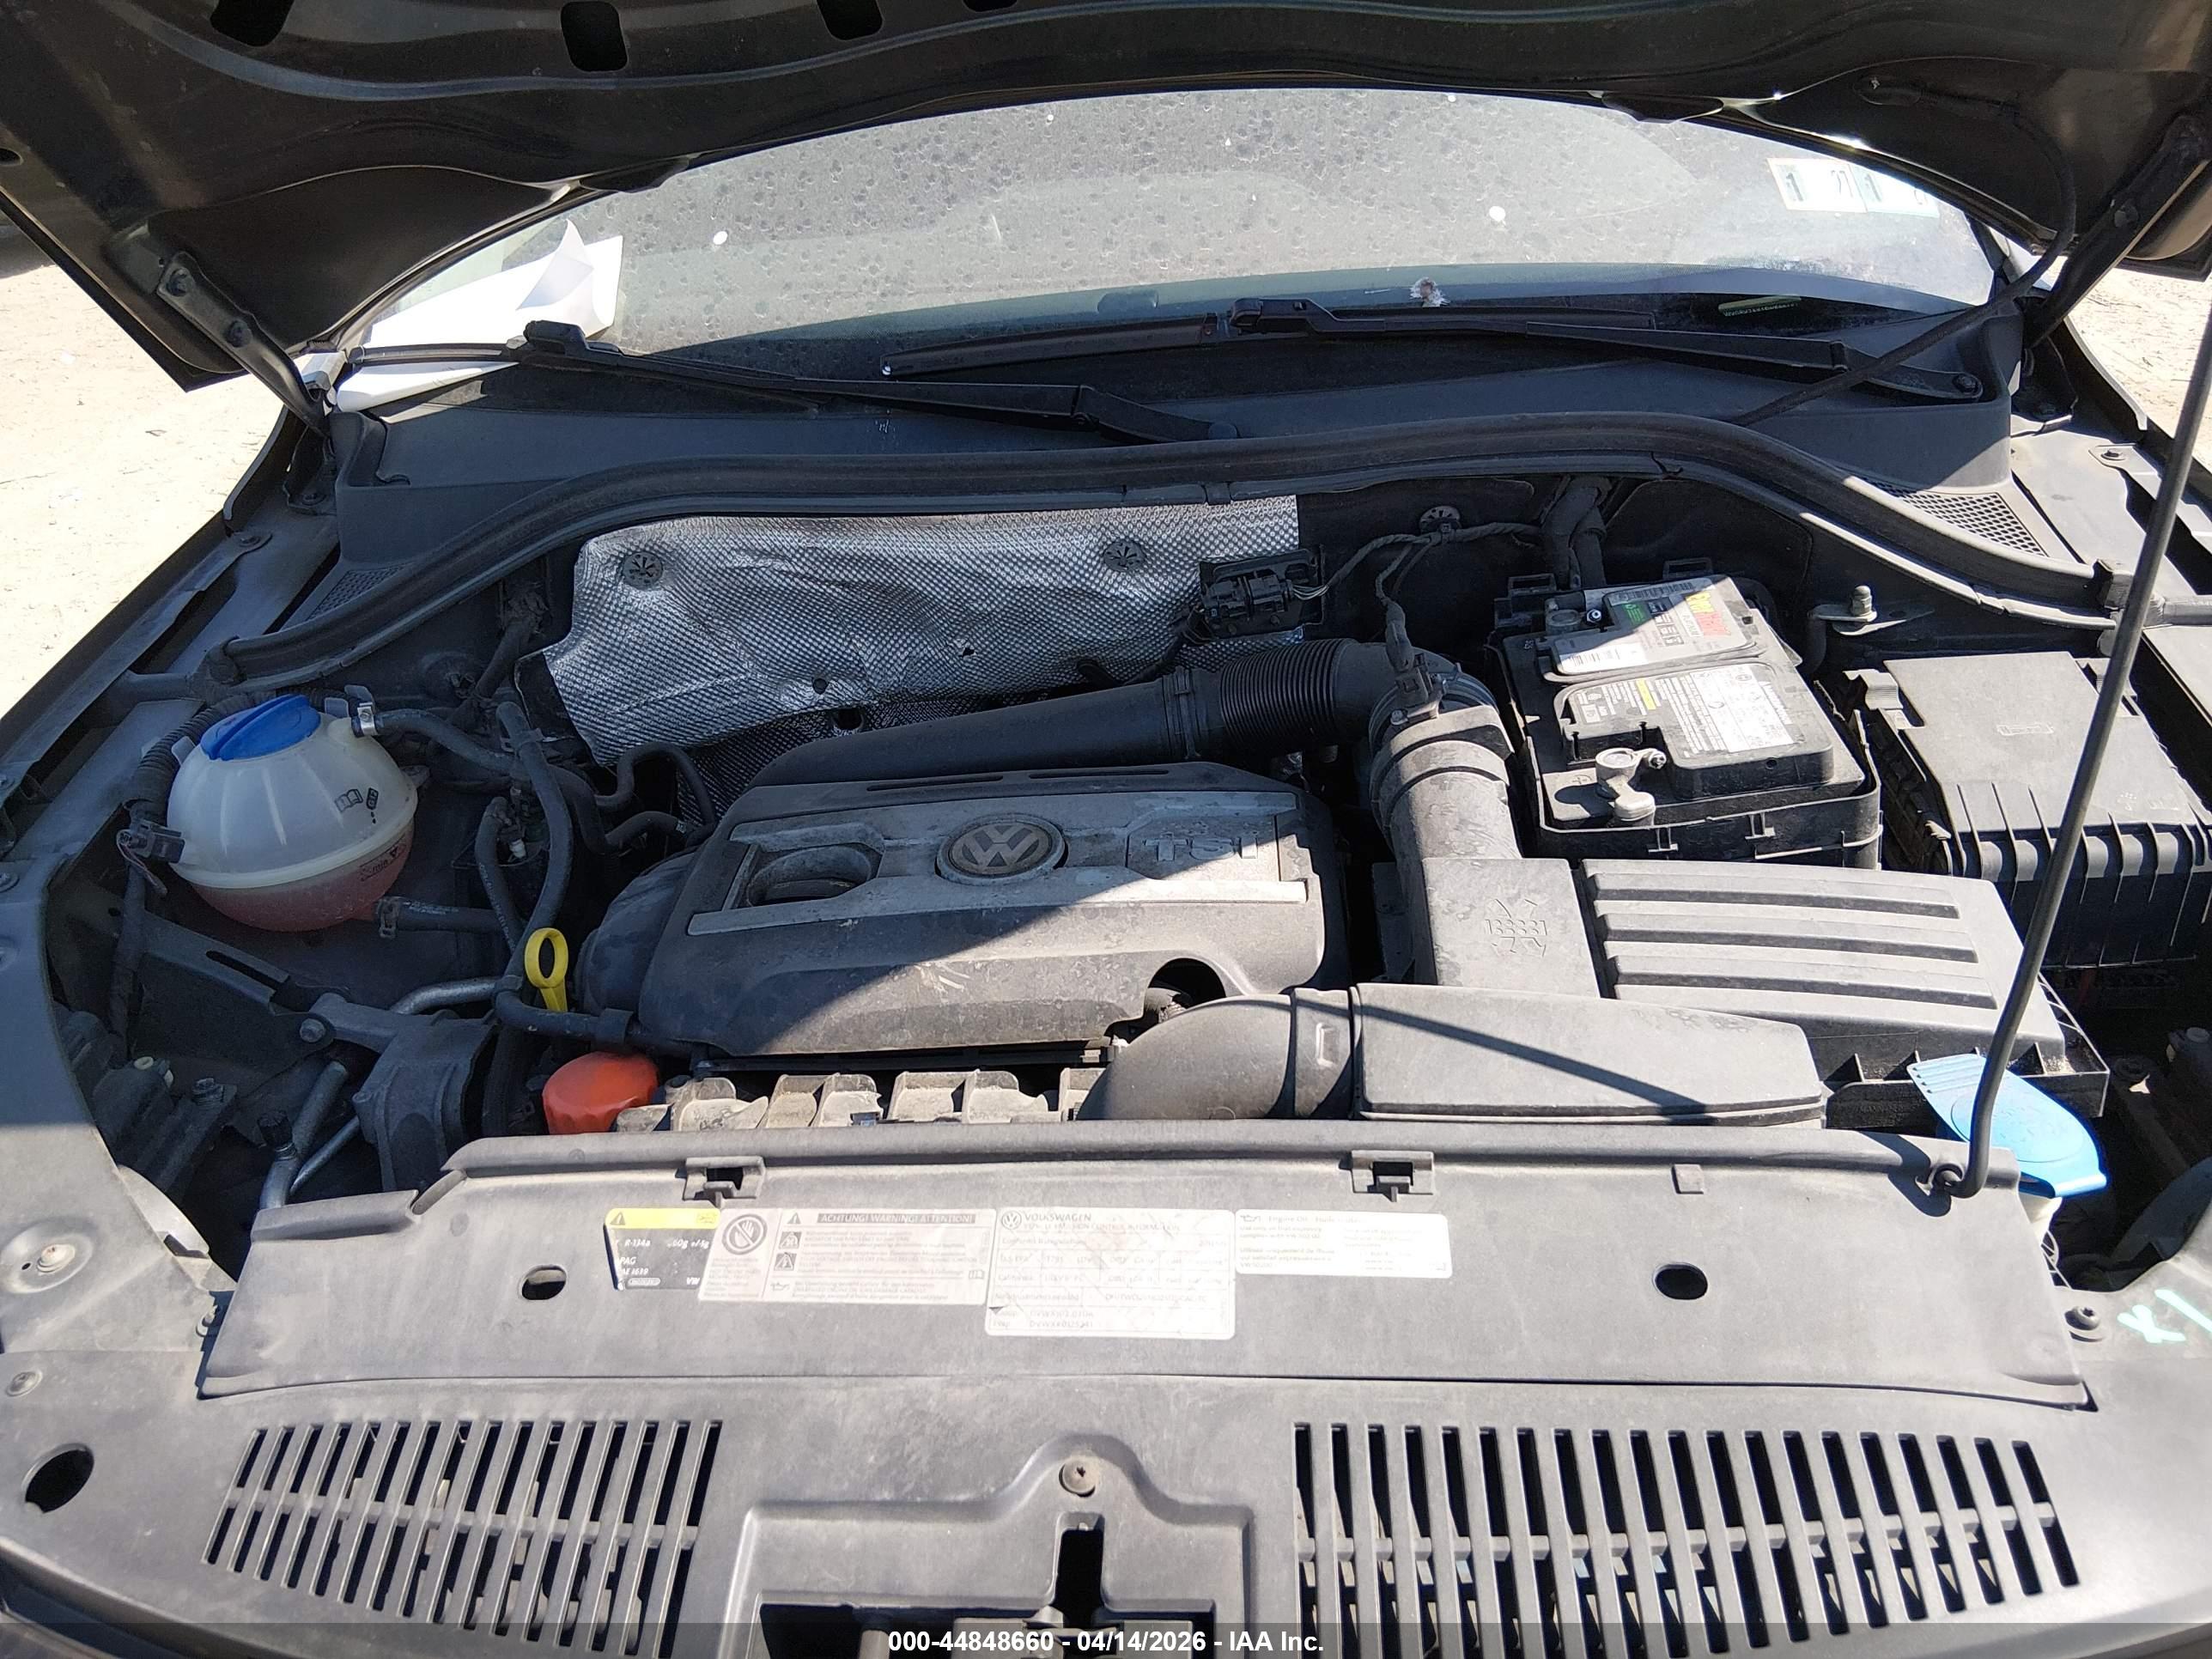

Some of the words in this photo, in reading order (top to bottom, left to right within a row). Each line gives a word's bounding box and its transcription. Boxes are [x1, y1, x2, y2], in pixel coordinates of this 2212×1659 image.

[1144, 836, 1258, 860] TSI
[821, 1213, 868, 1223] ACHTUNG!
[870, 1213, 918, 1223] WARNING!
[920, 1214, 973, 1224] ATTENTION!
[1024, 1212, 1091, 1222] VOLKSWAGEN
[619, 1256, 637, 1265] PAG
[686, 1277, 702, 1285] VW
